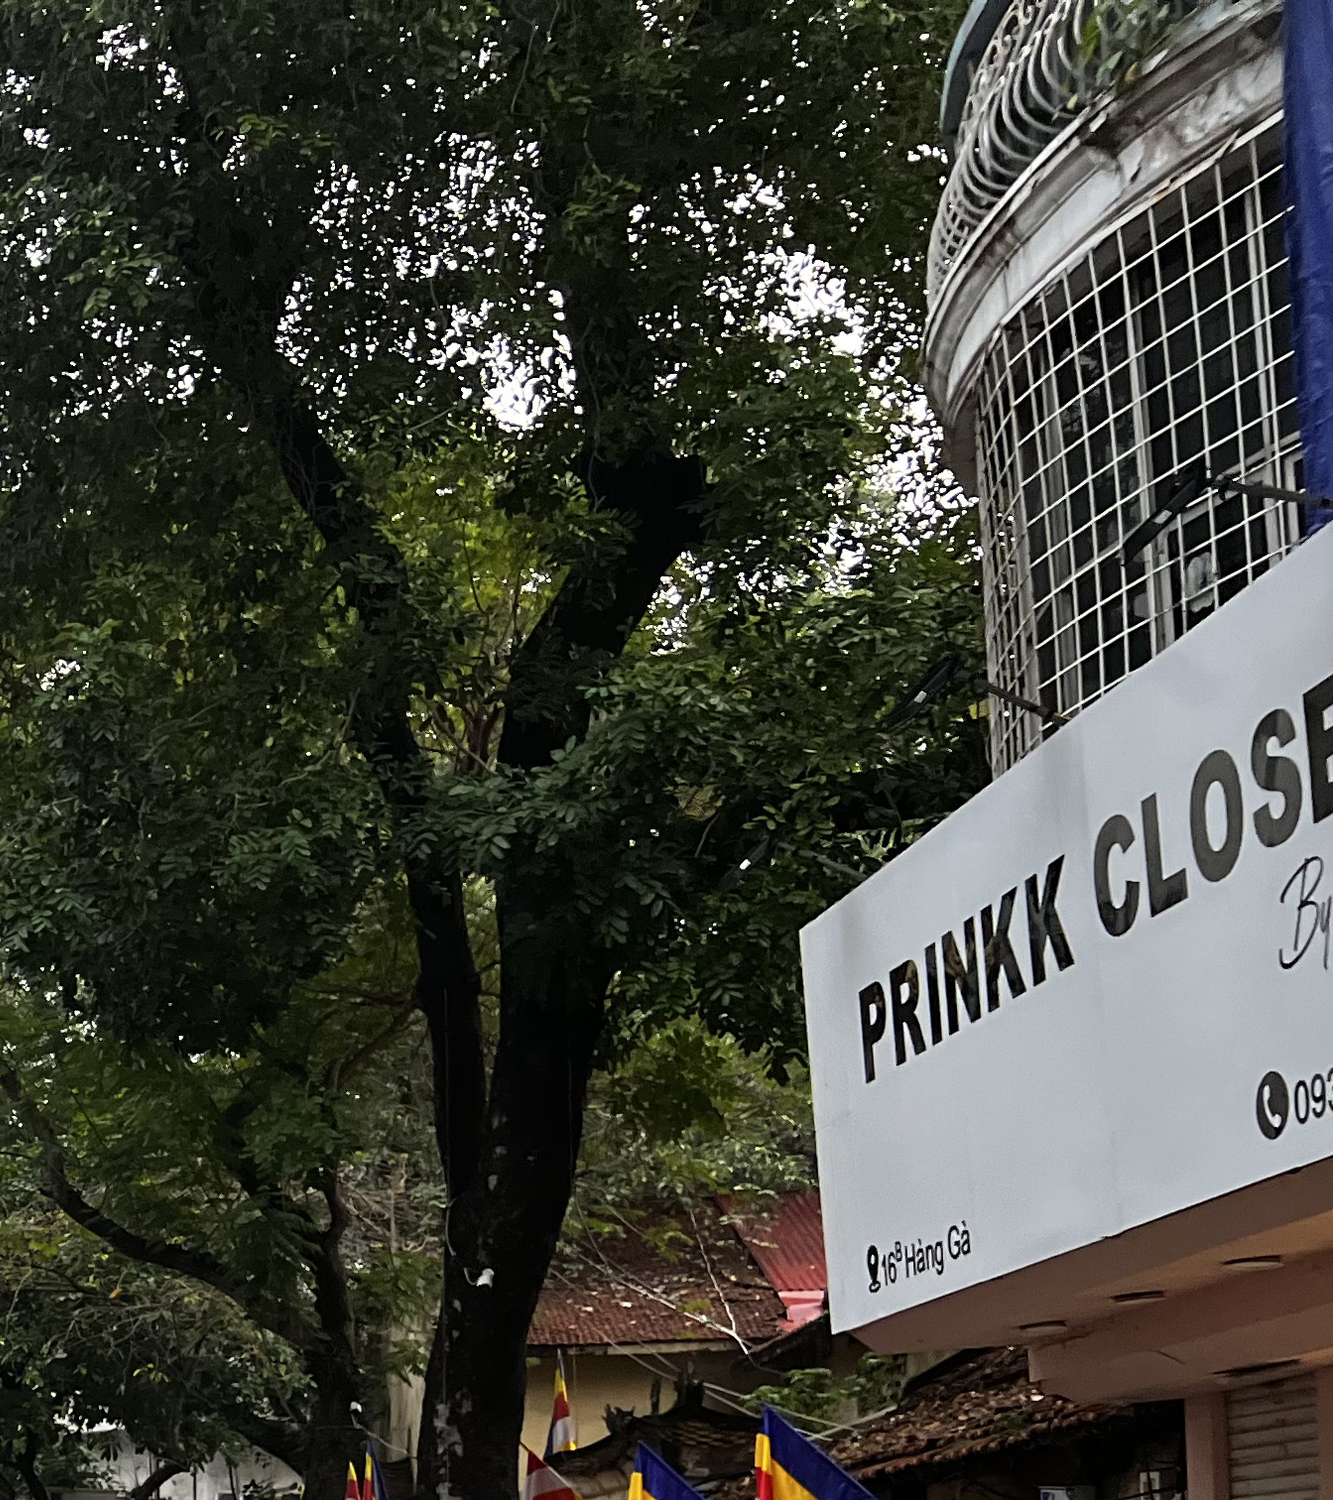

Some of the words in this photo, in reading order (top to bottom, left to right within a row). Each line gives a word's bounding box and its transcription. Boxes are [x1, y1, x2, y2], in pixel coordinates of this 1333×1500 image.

[858, 854, 1075, 1084] PRINKK
[904, 1238, 945, 1278] Hàng
[947, 1219, 971, 1259] Gà
